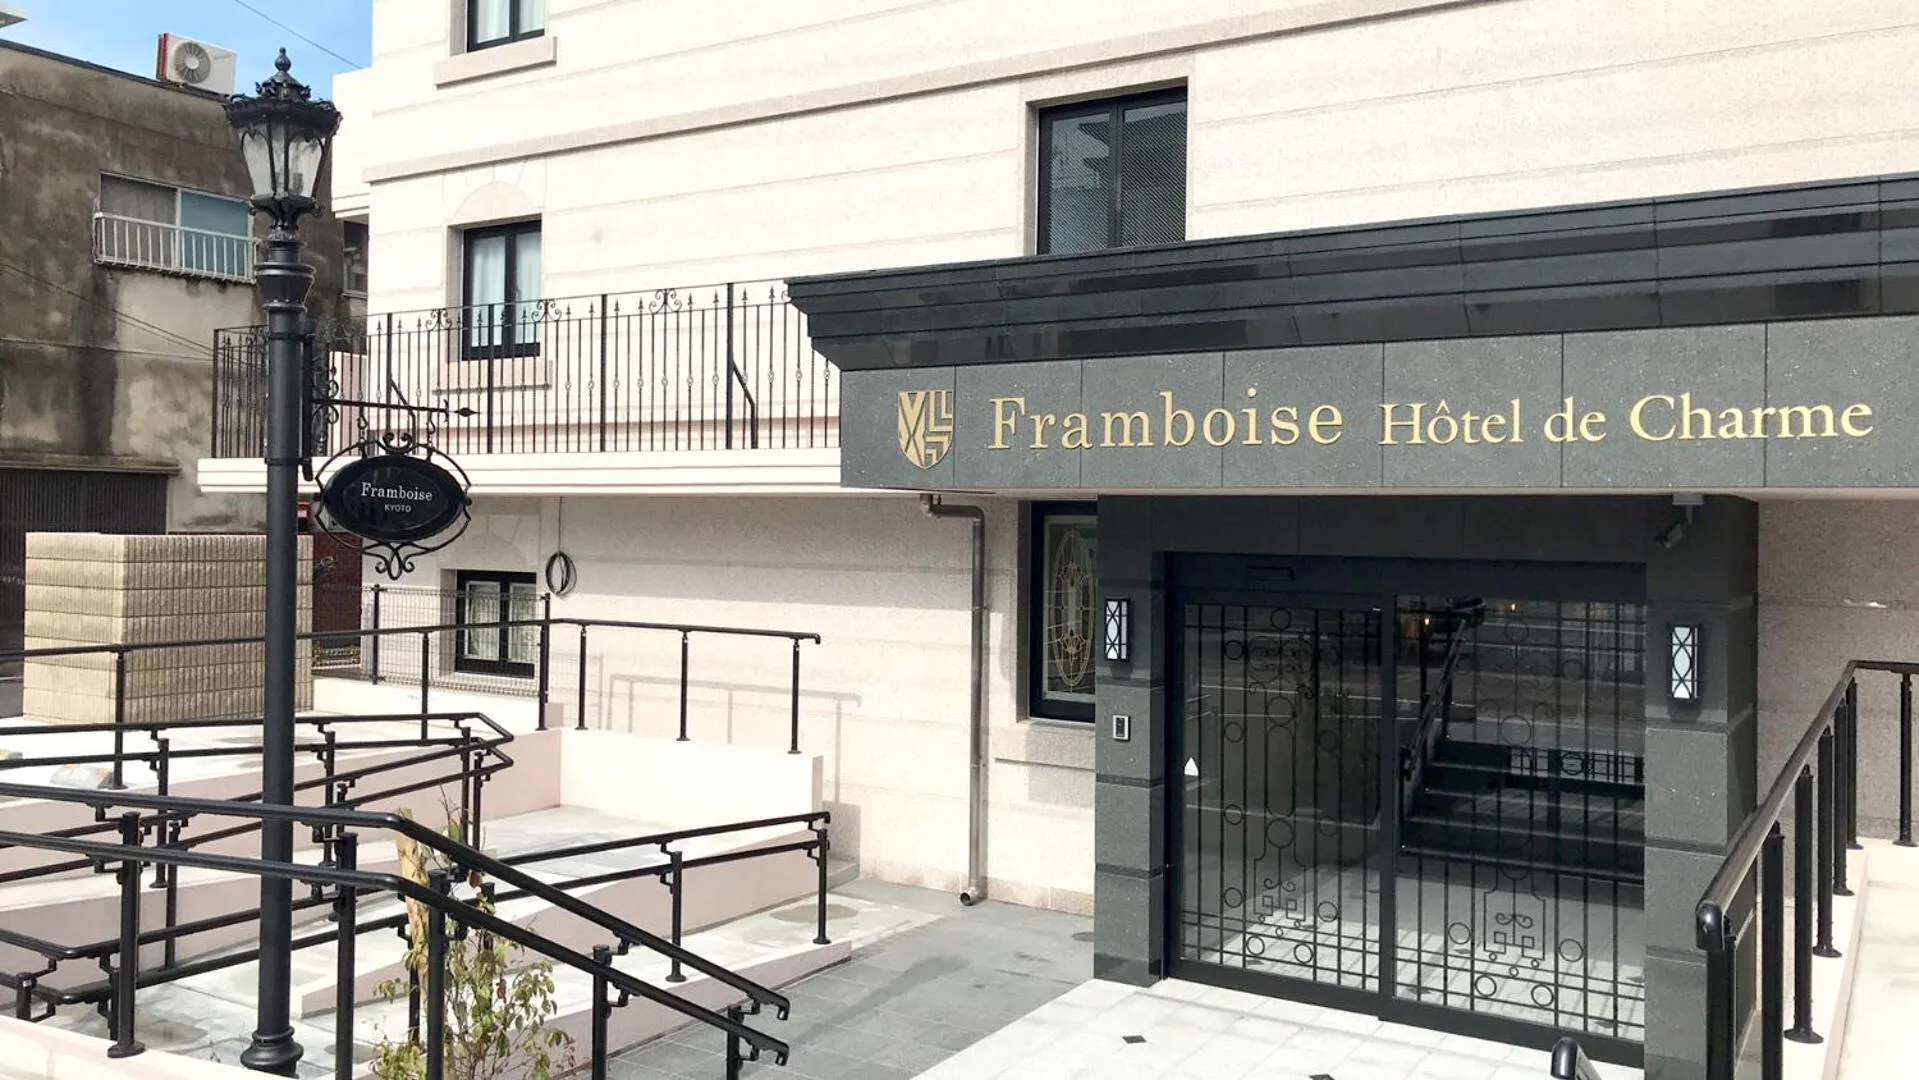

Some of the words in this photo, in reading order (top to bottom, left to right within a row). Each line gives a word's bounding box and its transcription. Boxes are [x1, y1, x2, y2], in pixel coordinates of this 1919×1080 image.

[988, 387, 1343, 450] Framboise
[1378, 397, 1523, 446] Hôtel
[1543, 397, 1607, 443] de
[1629, 392, 1874, 441] Charme
[361, 482, 432, 501] Framboise
[384, 503, 412, 513] KYOTO
